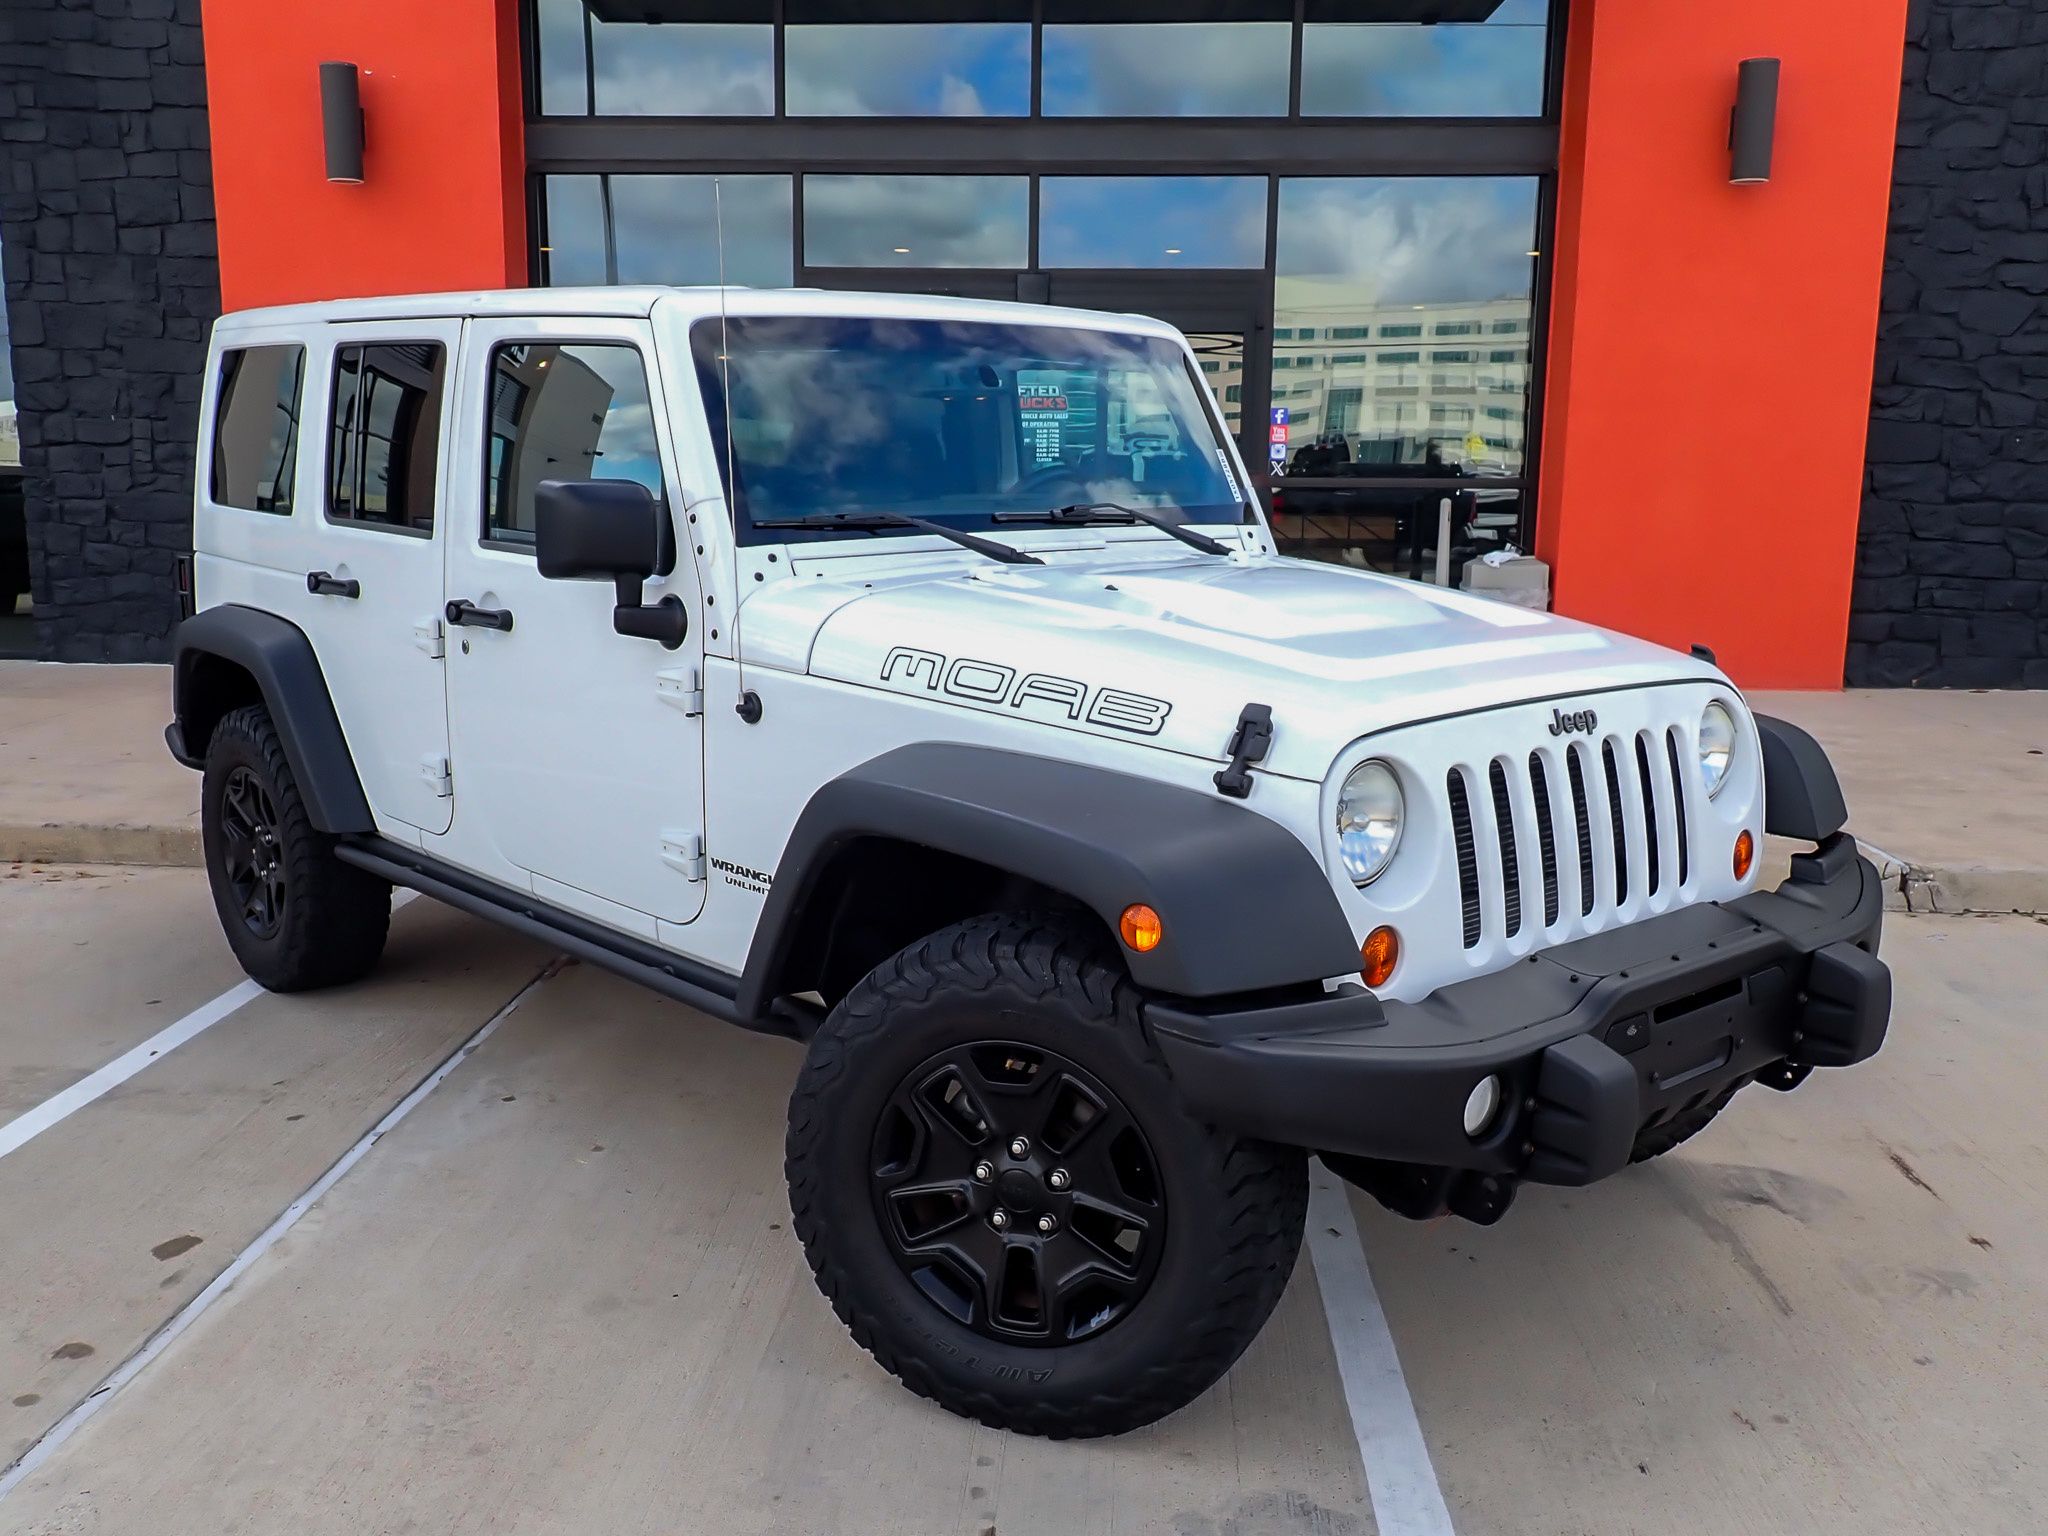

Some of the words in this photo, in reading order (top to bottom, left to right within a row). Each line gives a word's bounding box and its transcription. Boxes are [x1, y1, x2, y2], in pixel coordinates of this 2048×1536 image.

[1018, 385, 1059, 396] FTED
[1020, 397, 1067, 409] UCKS
[880, 646, 1173, 736] MOAB
[1548, 708, 1598, 737] Jeep
[711, 857, 773, 884] WRANG
[725, 876, 769, 895] UNLIMI
